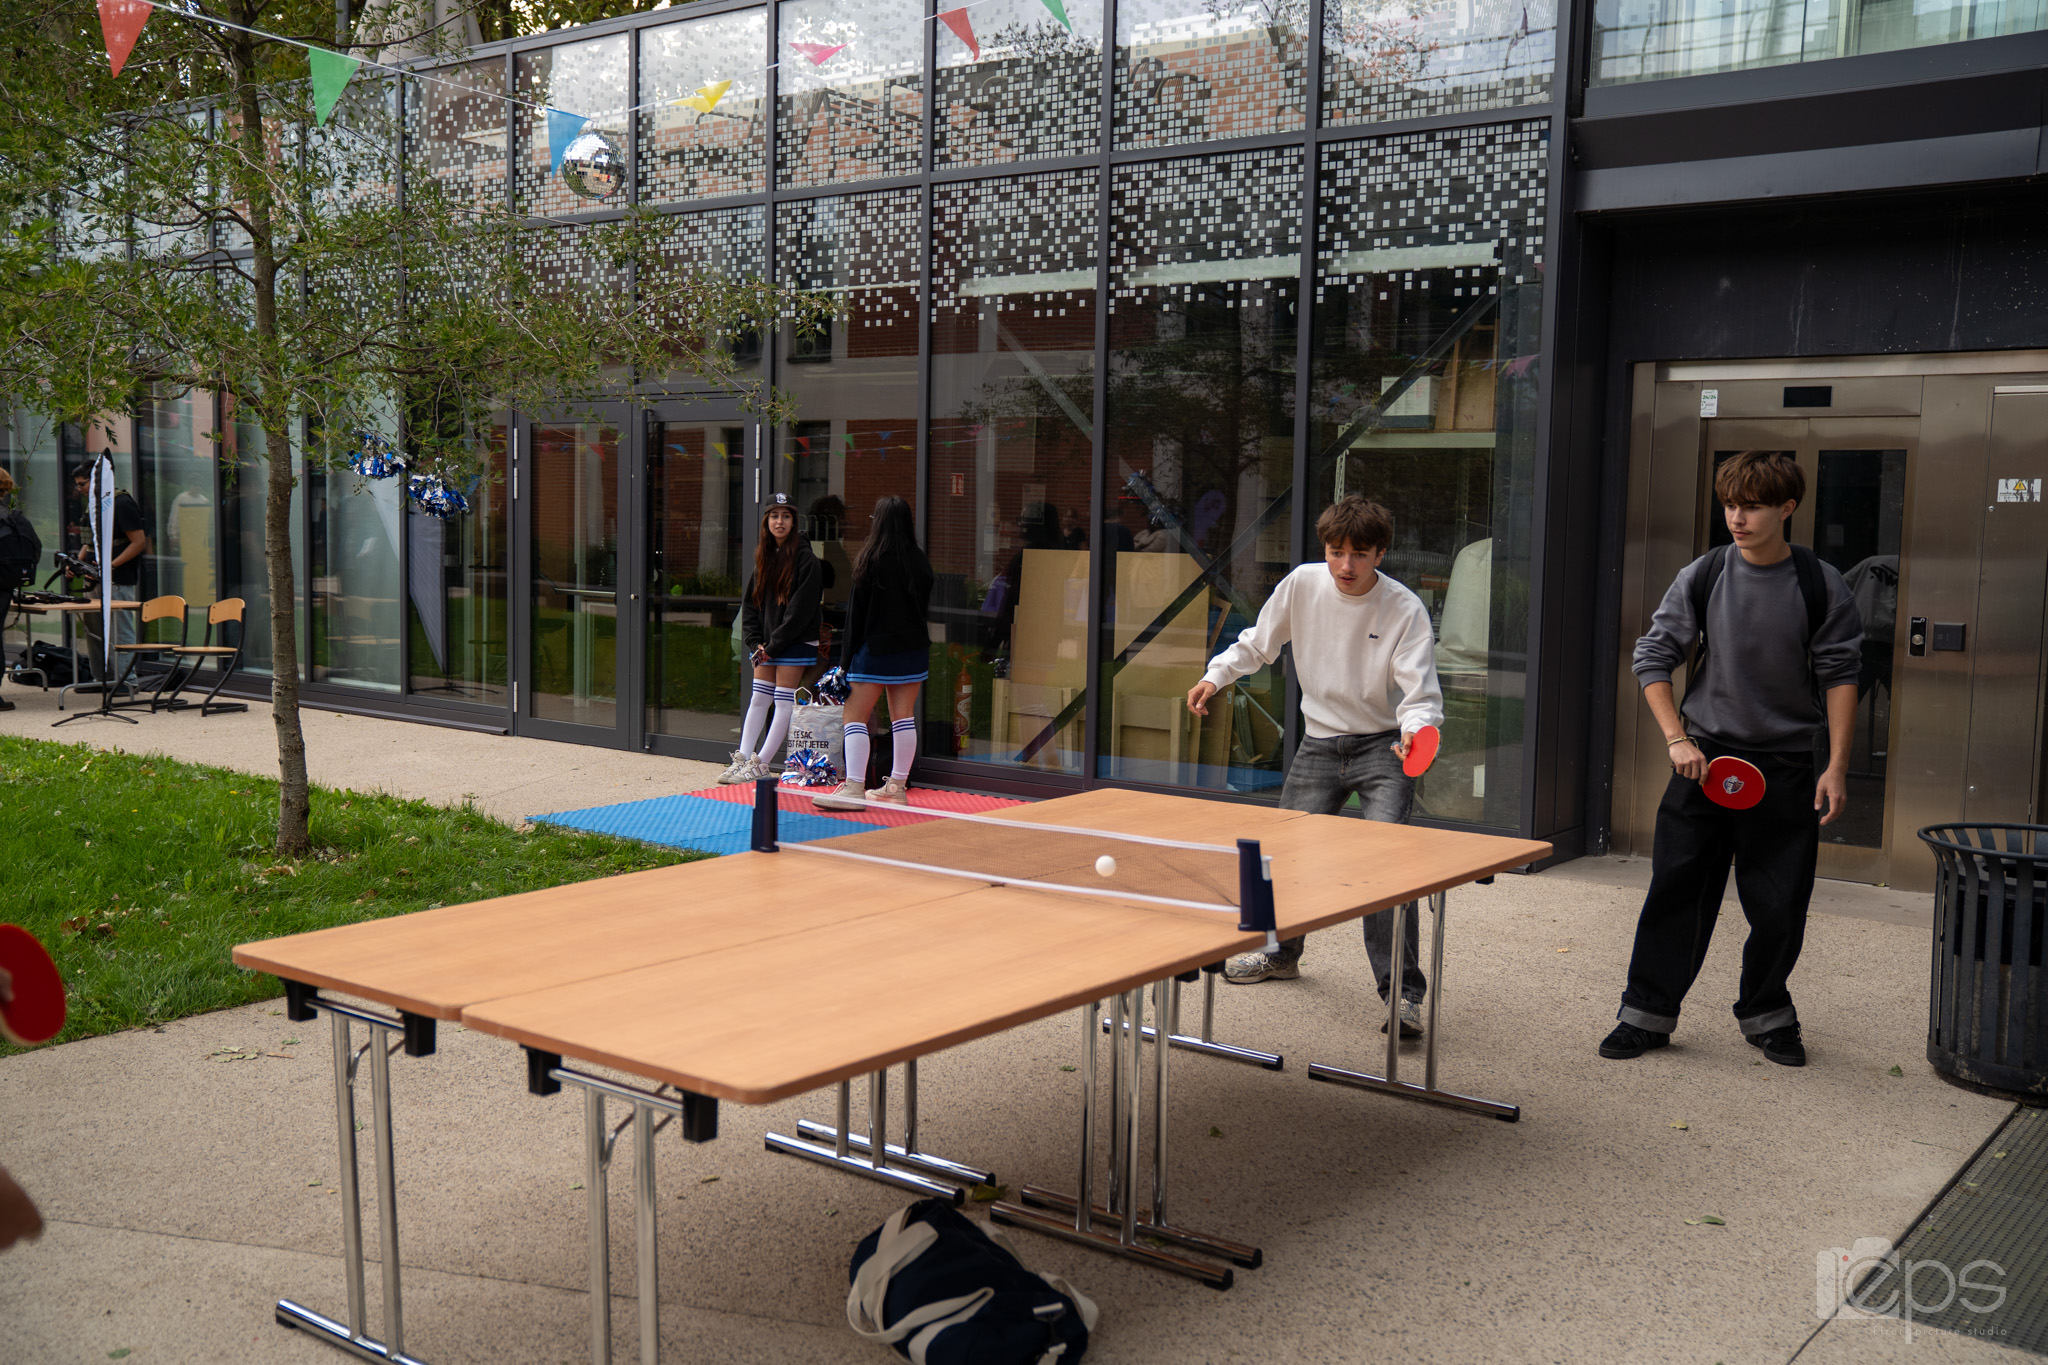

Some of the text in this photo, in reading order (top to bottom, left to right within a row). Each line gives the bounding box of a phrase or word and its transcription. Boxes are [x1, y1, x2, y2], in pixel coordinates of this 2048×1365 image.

[794, 730, 812, 739] CE SAC
[796, 740, 808, 748] FAIT
[809, 740, 829, 749] JETER
